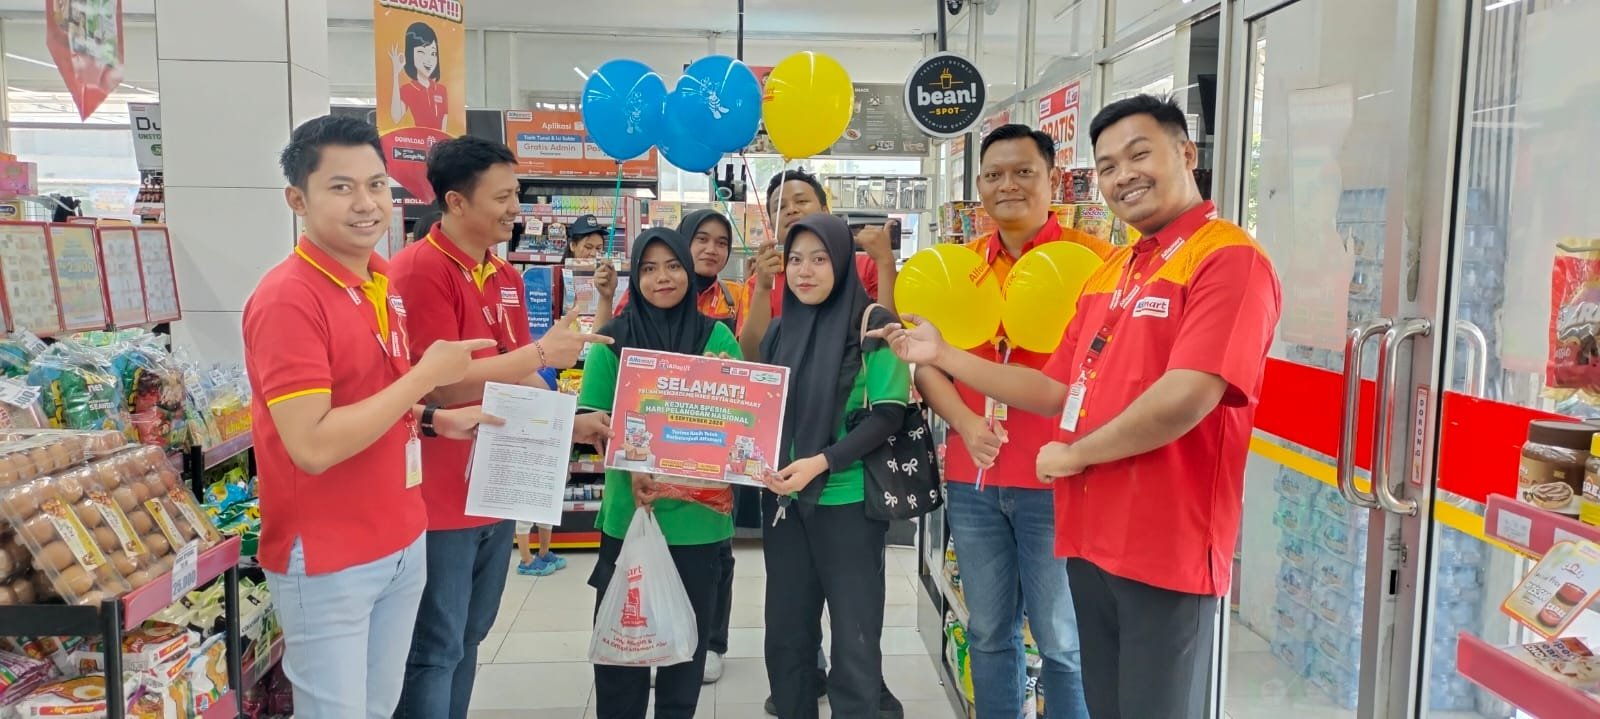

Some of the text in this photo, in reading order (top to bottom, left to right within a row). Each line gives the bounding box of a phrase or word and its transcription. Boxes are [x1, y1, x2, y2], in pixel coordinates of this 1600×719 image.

[917, 82, 977, 106] bean!
[935, 107, 960, 115] SPOT
[541, 122, 571, 130] Aplikasi
[394, 136, 425, 145] DOWNLOAD
[523, 143, 576, 152] Gratis Admin
[656, 376, 746, 400] SELAMAT!
[664, 401, 732, 414] KEJUTAN SPESIAL
[729, 397, 762, 409] ALFAMART
[675, 415, 708, 424] SEPTEMBER
[711, 412, 750, 424] NASIONAL
[1415, 399, 1425, 457] DORONG
